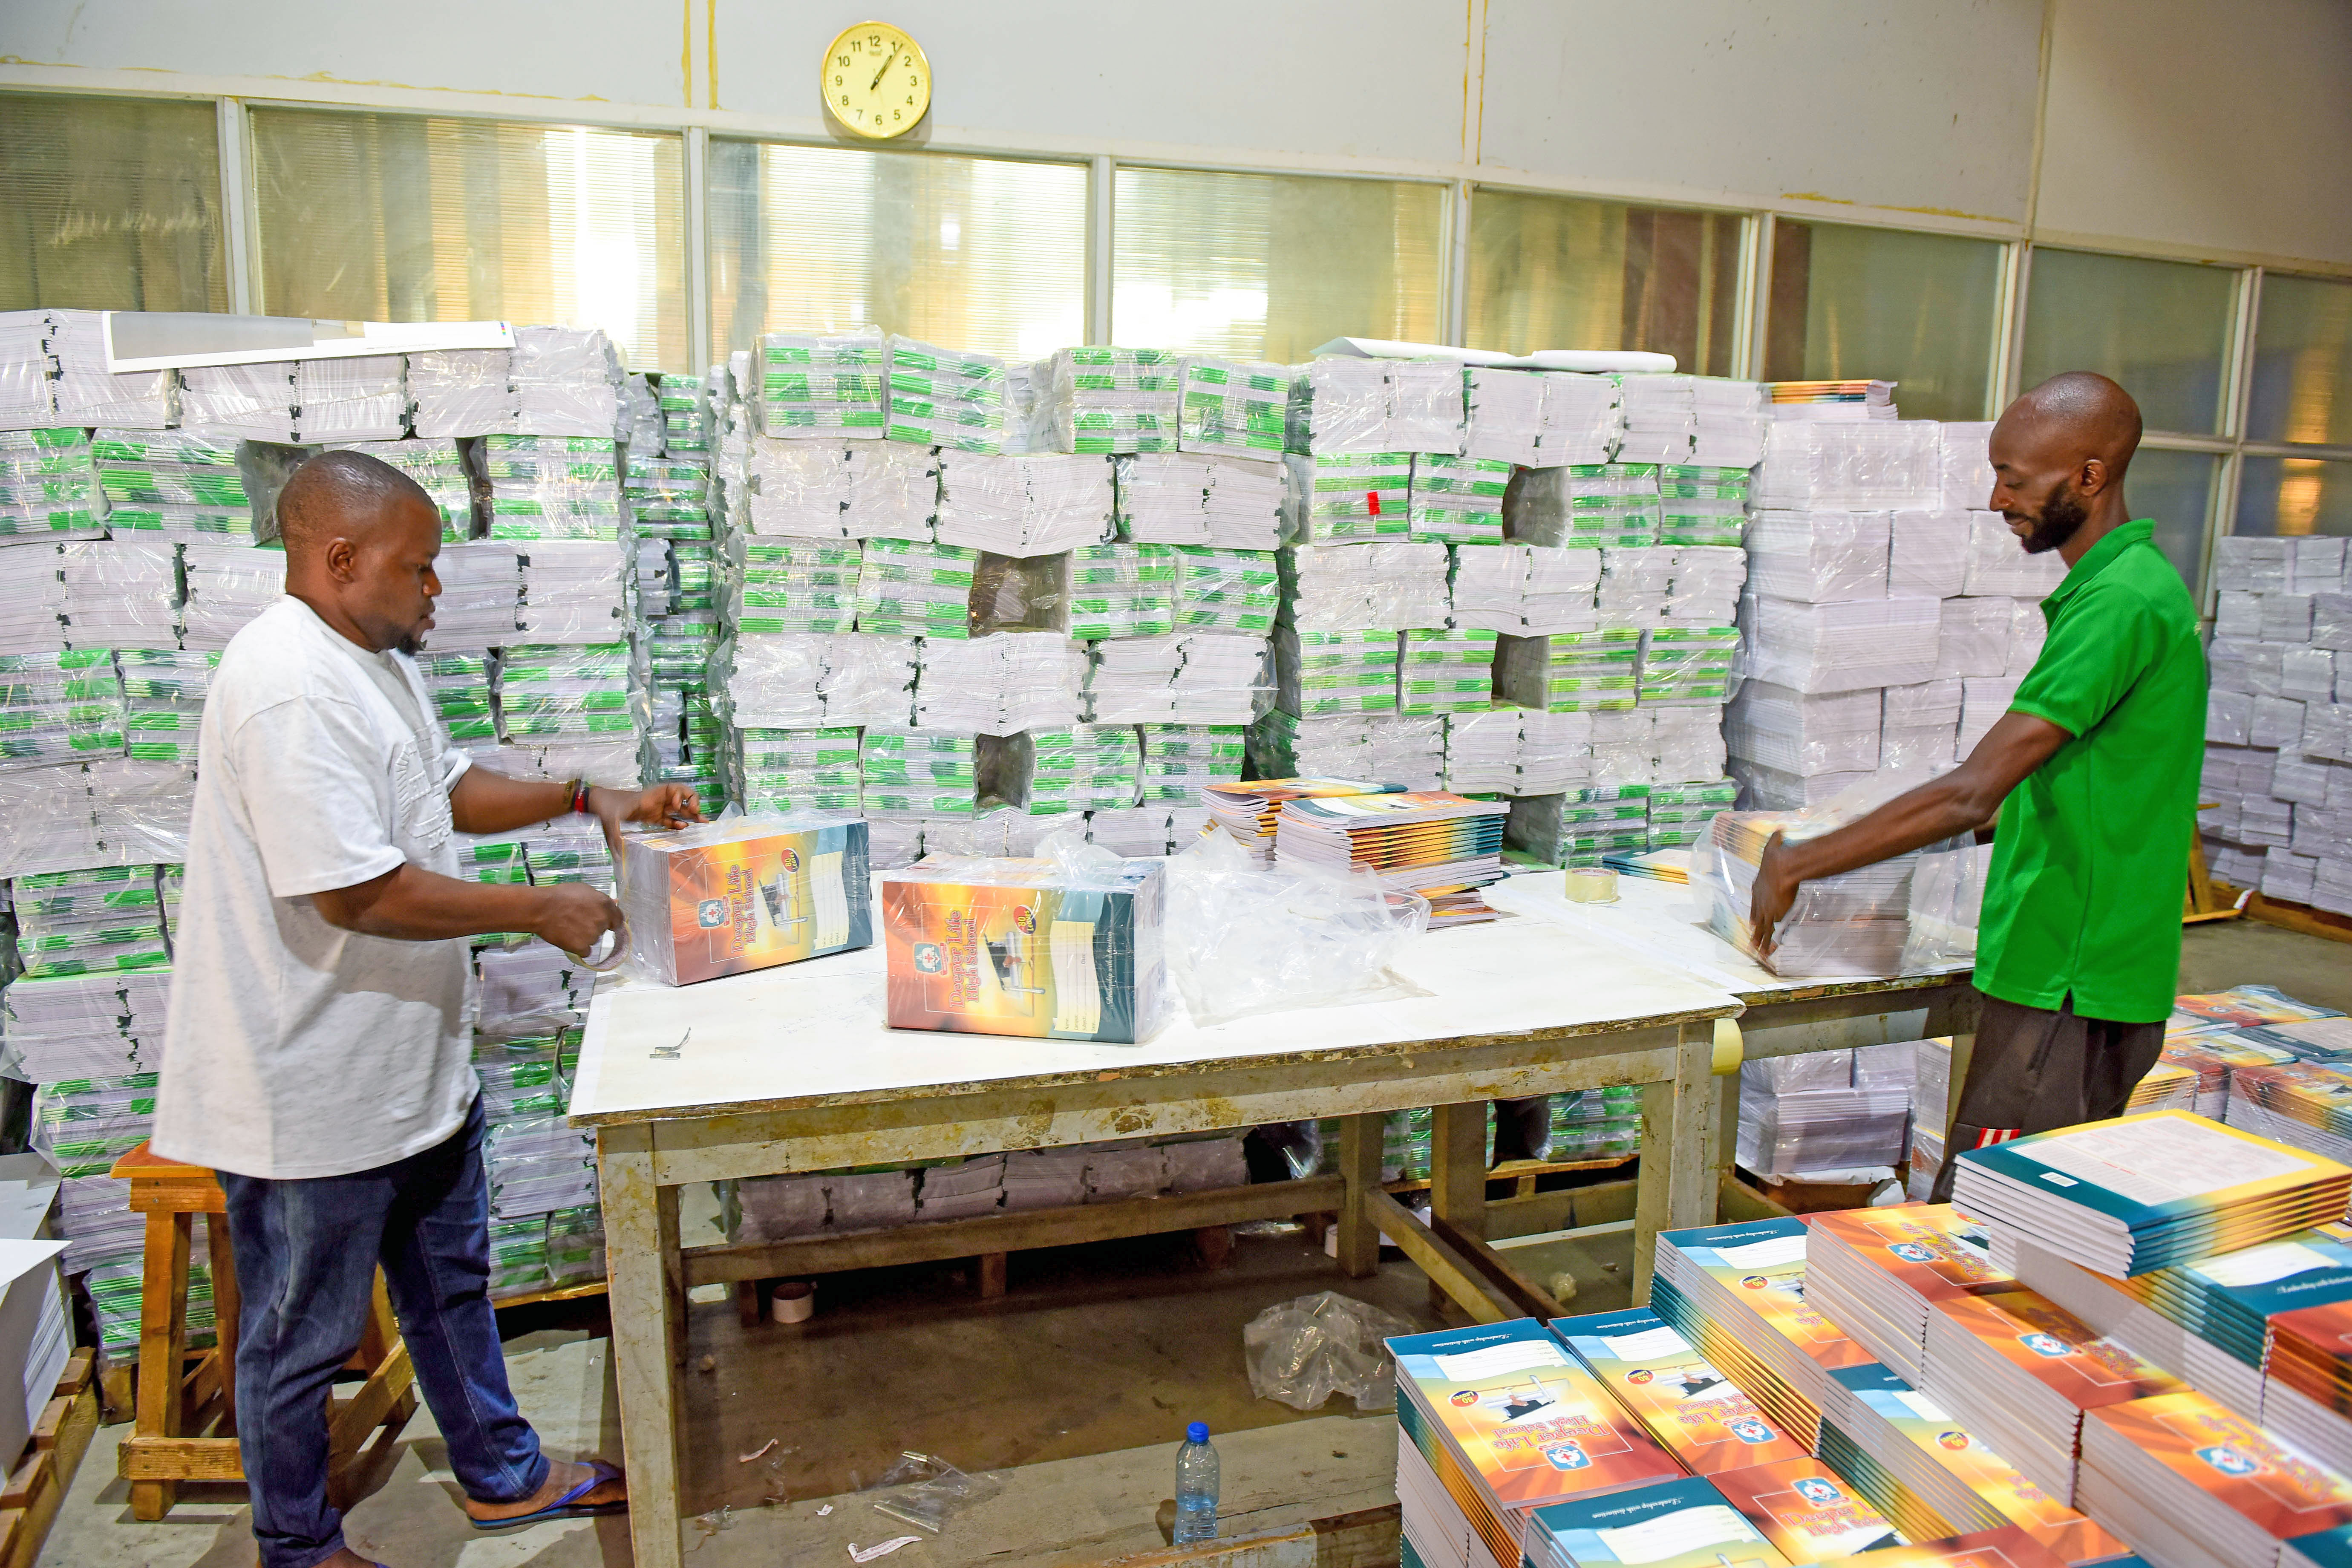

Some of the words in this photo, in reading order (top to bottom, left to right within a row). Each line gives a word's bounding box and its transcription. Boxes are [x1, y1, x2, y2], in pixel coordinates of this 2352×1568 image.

[851, 41, 861, 52] 11
[868, 35, 880, 46] 12
[891, 41, 896, 51] 1
[838, 56, 850, 66] 10
[904, 56, 911, 66] 2
[835, 75, 842, 86] 9
[910, 75, 917, 86] 3
[842, 95, 849, 105] 8
[906, 96, 913, 105] 4
[856, 110, 863, 119] 7
[875, 115, 882, 125] 6
[894, 110, 900, 120] 5
[784, 858, 792, 867] 80
[789, 852, 798, 869] Leaves
[726, 865, 741, 896] Life
[741, 868, 755, 911] School
[729, 898, 746, 954] Deeper
[743, 912, 758, 944] High
[946, 911, 962, 944] Life
[1018, 917, 1026, 927] 80
[1024, 910, 1035, 931] Leaves
[963, 918, 978, 965] School
[948, 948, 966, 1007] Deeper
[964, 968, 981, 1002] High
[1899, 1222, 1932, 1242] Life
[1929, 1242, 1988, 1280] Deeper
[1637, 1317, 1661, 1326] eadership
[1796, 1316, 1825, 1327] ife
[1629, 1370, 1649, 1378] Leaves
[1452, 1391, 1475, 1401] Leaves
[1674, 1398, 1725, 1415] School
[1719, 1402, 1758, 1418] eper
[1549, 1414, 1590, 1429] High
[1677, 1411, 1718, 1426] Life
[1490, 1422, 1546, 1438] School
[1535, 1422, 1611, 1443] Deeper
[1492, 1435, 1535, 1452] Life
[1592, 1509, 1626, 1519] distinction
[1781, 1507, 1858, 1526] Deeper
[1805, 1522, 1850, 1537] High
[1850, 1515, 1890, 1528] Scho
